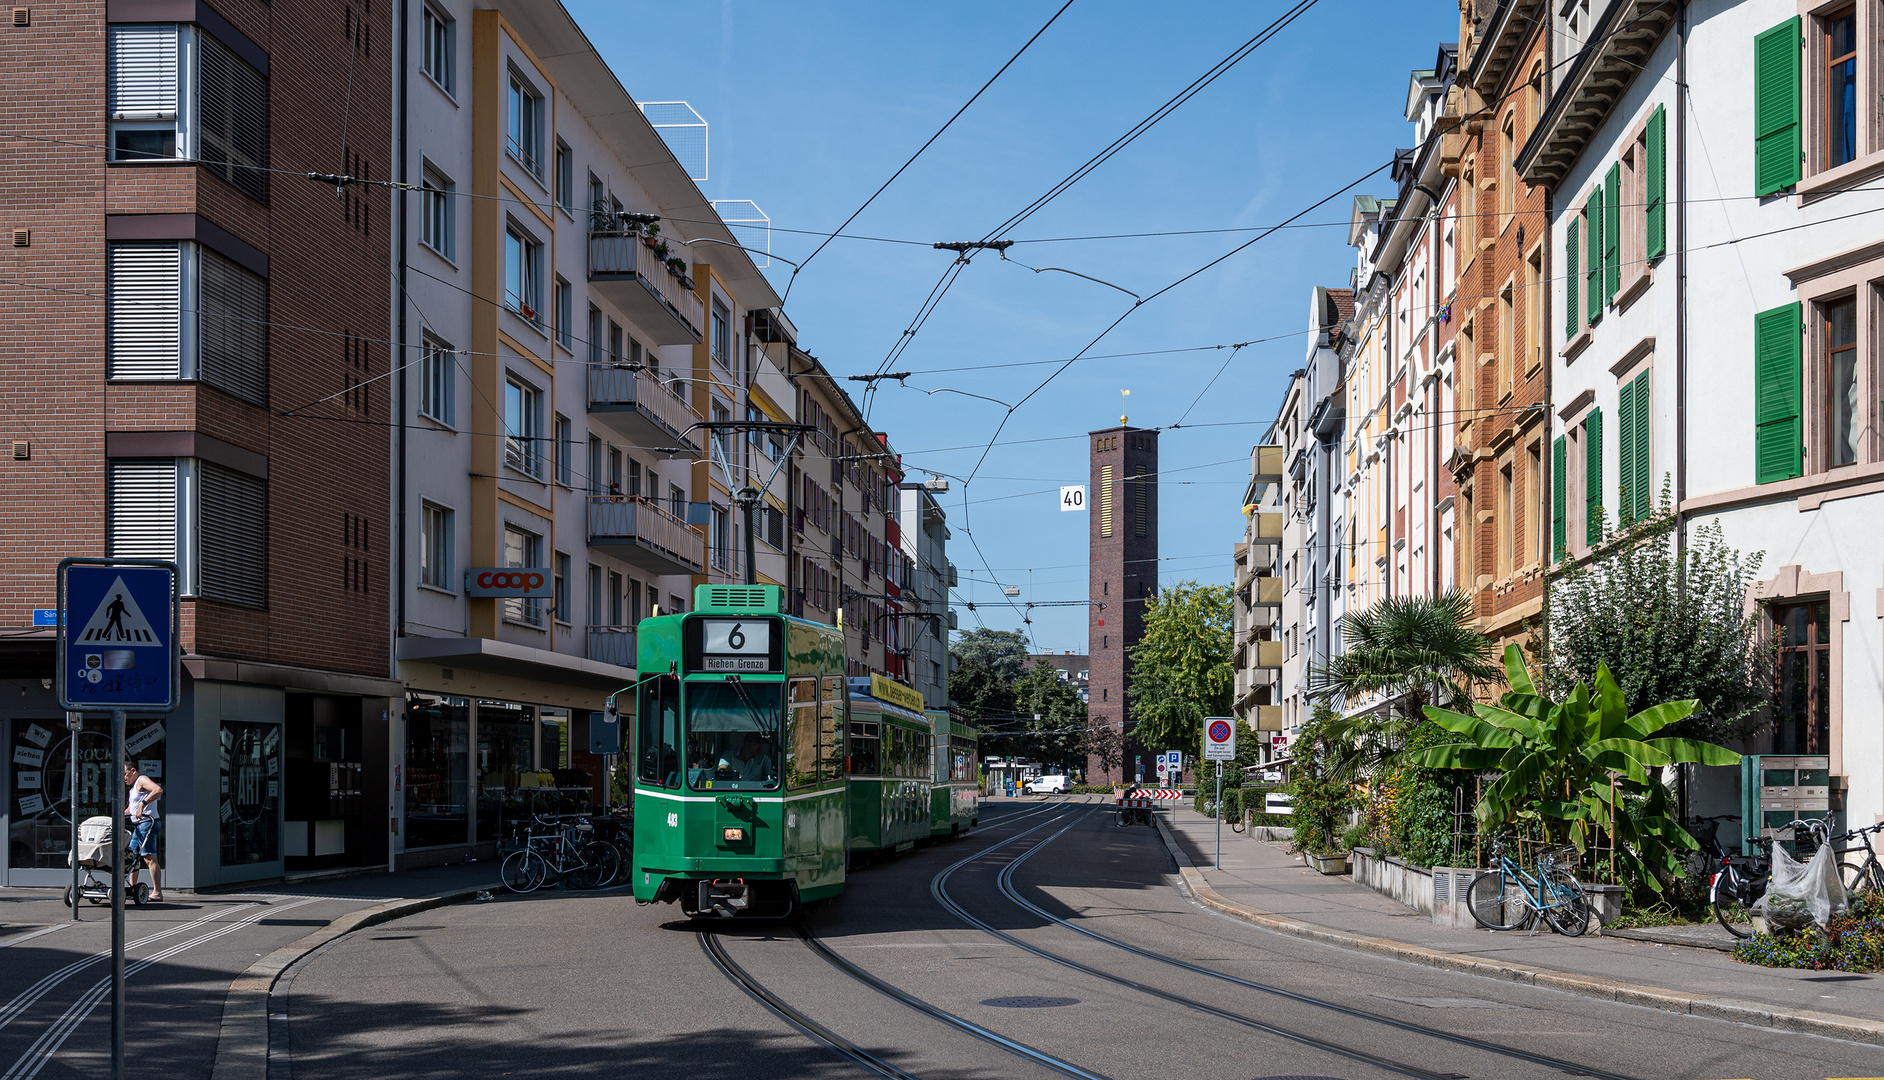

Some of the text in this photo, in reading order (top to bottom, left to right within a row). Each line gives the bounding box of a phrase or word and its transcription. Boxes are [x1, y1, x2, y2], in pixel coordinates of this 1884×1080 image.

[1063, 490, 1082, 506] 40
[477, 572, 544, 593] coop
[728, 622, 745, 650] 6
[708, 658, 764, 669] Riehen Grenze
[34, 728, 45, 739] Wir
[126, 728, 159, 749] Deswegen
[17, 750, 41, 760] ziehen
[61, 762, 113, 804] ART
[237, 766, 261, 805] ART
[667, 812, 678, 828] 483
